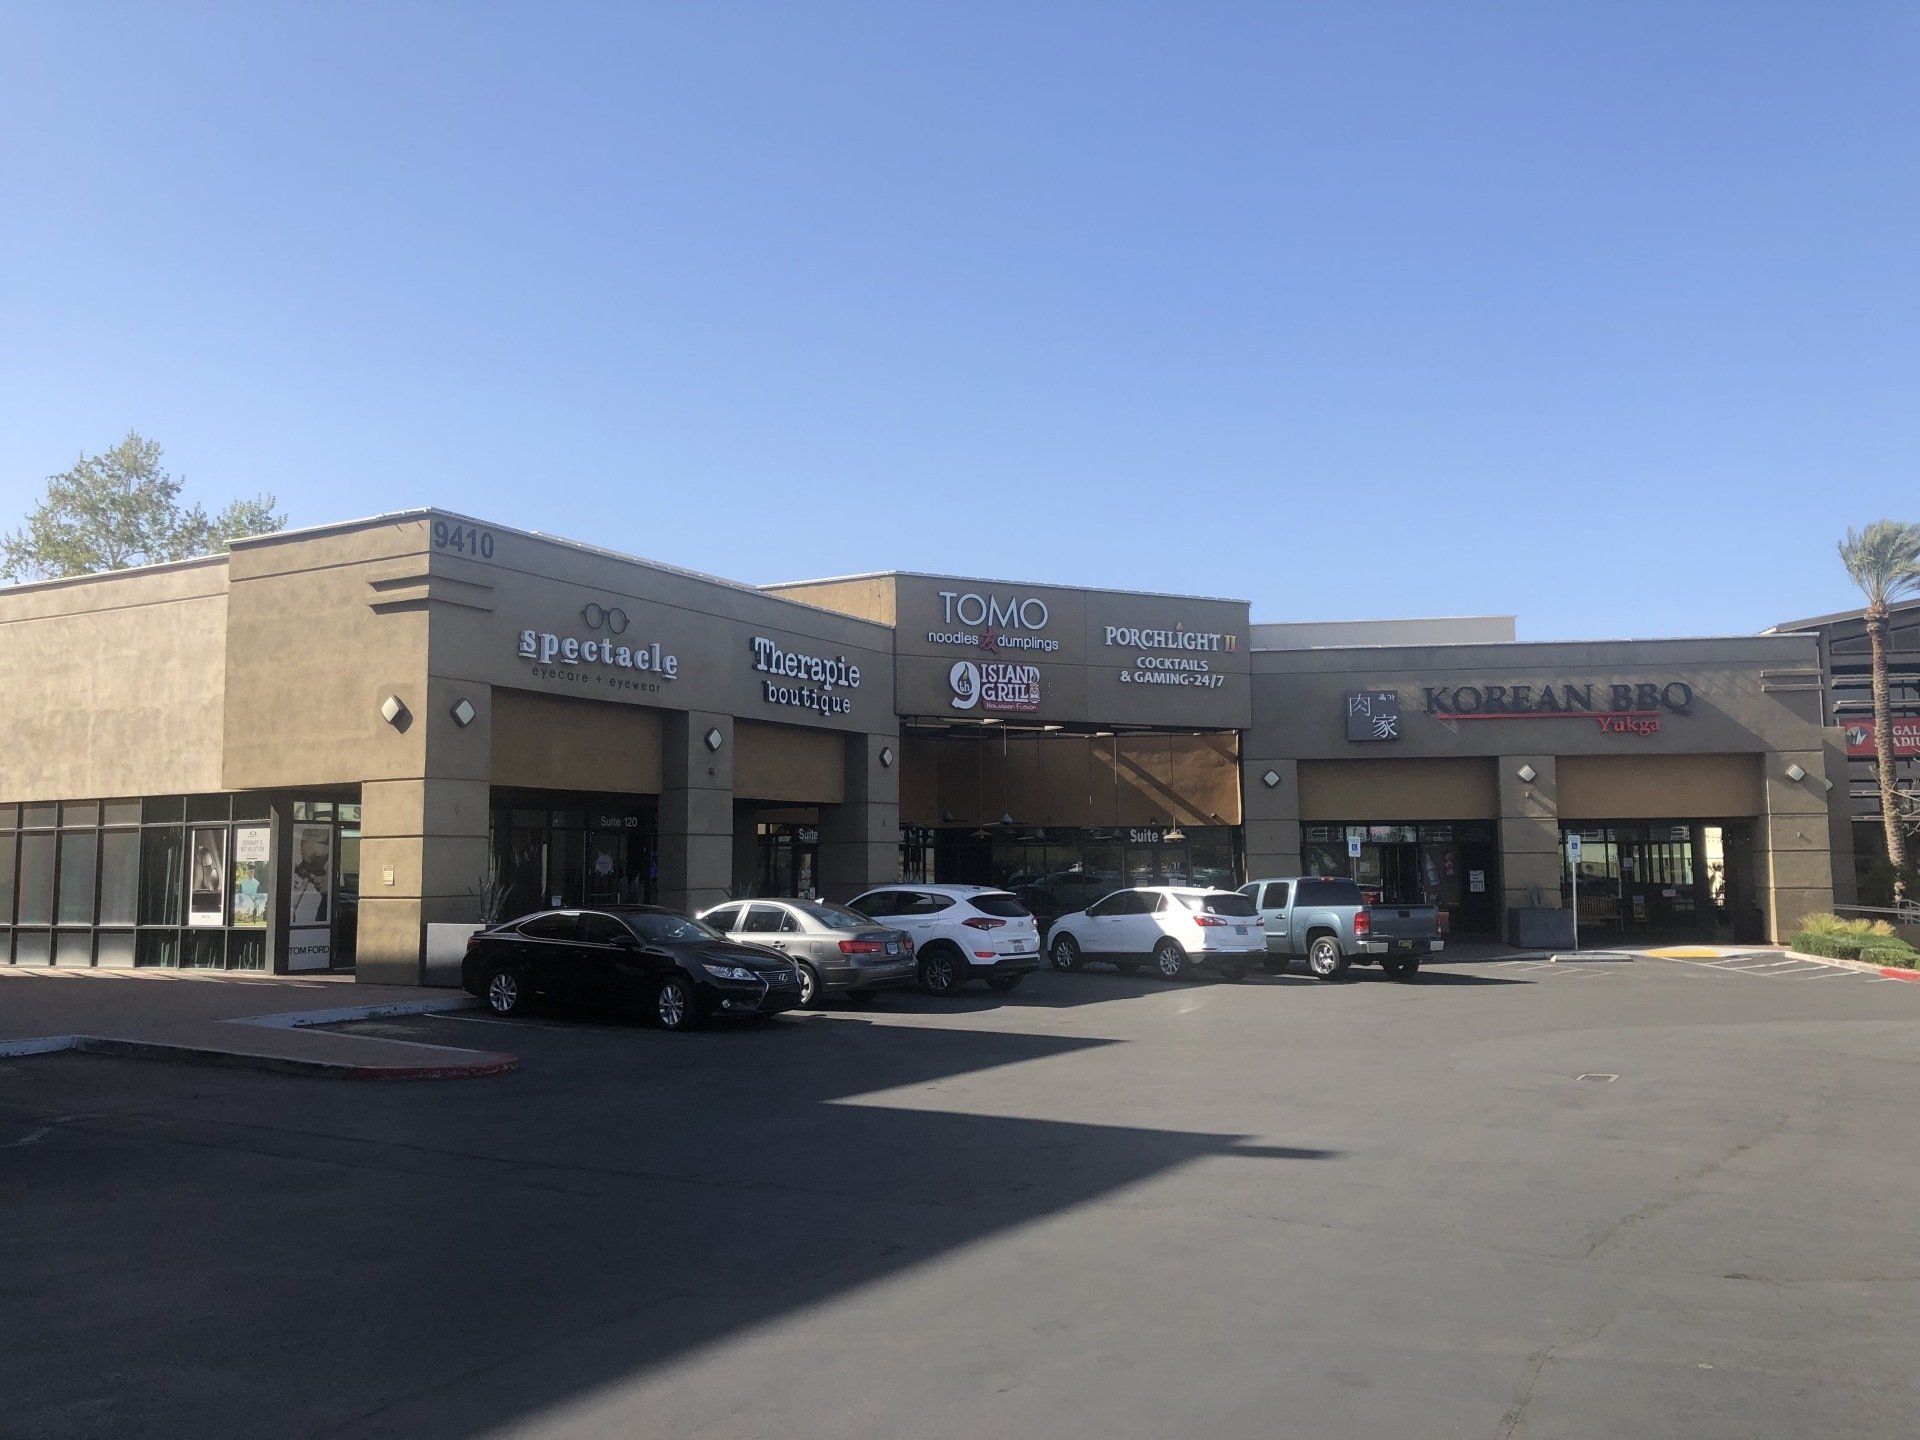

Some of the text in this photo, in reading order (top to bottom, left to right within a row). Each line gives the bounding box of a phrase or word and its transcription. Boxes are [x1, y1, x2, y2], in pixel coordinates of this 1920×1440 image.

[433, 520, 495, 559] 9410
[939, 591, 1048, 630] TOMO
[928, 627, 1059, 654] noodles 友 dumplings
[1104, 625, 1220, 651] PORCHLIGHT
[518, 629, 679, 680] spectacle
[750, 636, 860, 691] Therapie
[1136, 656, 1208, 672] COCKTAILS
[531, 665, 588, 685] eyecare
[609, 675, 662, 694] eyewear
[981, 664, 1041, 684] ISLAND
[1120, 670, 1132, 683] &
[762, 680, 851, 716] boutique
[981, 684, 1029, 703] GRILL
[1422, 682, 1693, 716] KOREAN BBQ
[1596, 715, 1662, 736] Yukga
[600, 816, 621, 828] Suite
[799, 828, 818, 840] Suite
[1130, 829, 1159, 843] Suite
[289, 945, 330, 956] TOM FORD
